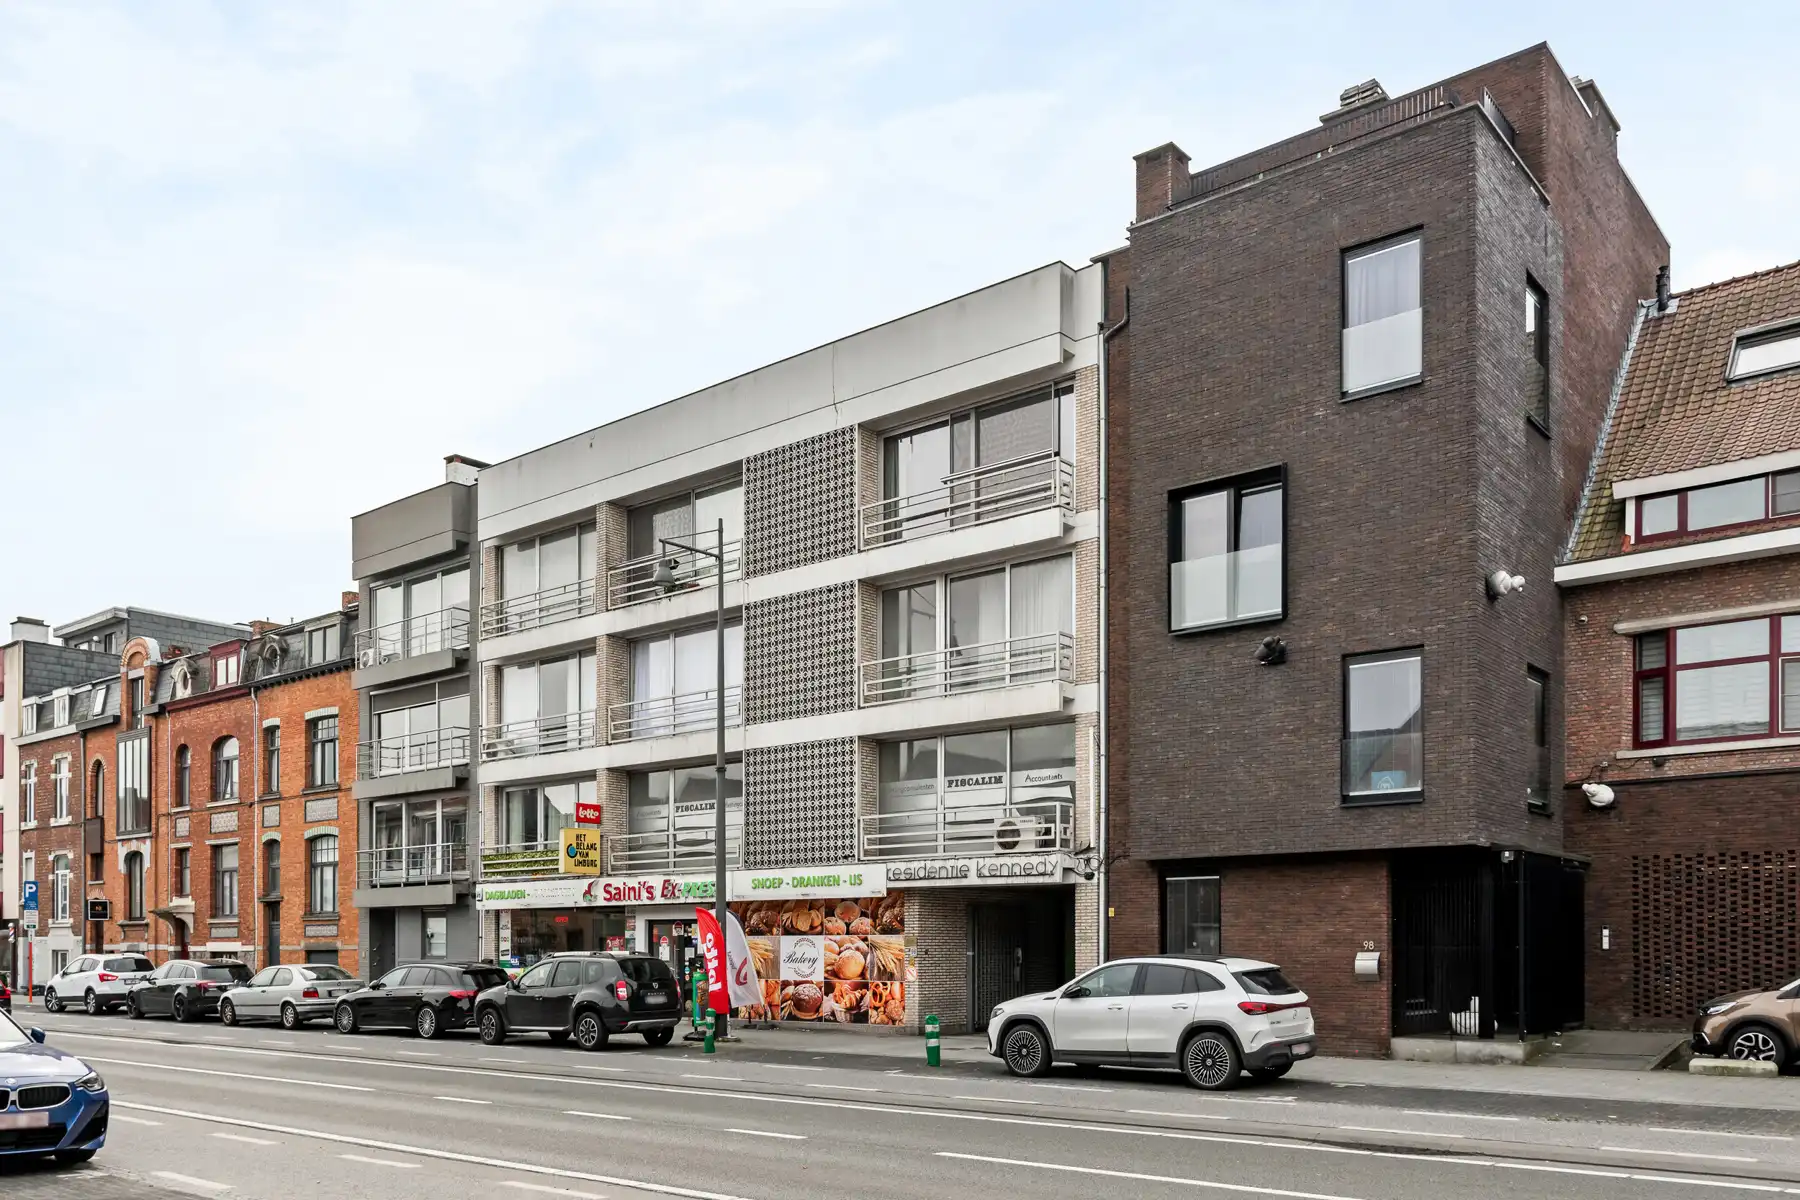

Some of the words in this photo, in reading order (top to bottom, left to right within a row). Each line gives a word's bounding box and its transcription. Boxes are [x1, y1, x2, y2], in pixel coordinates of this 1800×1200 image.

[947, 776, 1003, 788] FISCALIM
[1025, 773, 1063, 783] Accountants
[675, 802, 716, 813] FISCALIM
[576, 842, 597, 850] BELANG
[574, 859, 597, 867] LIMBURG
[976, 857, 1058, 877] kennedy
[751, 877, 784, 889] SNOEP
[791, 874, 840, 888] DRANKEN
[25, 883, 37, 897] P
[485, 889, 526, 900] DAGBLADEN
[602, 881, 656, 902] Saini's
[1363, 940, 1375, 950] 98
[702, 931, 718, 993] lotto
[782, 951, 818, 969] Bakery
